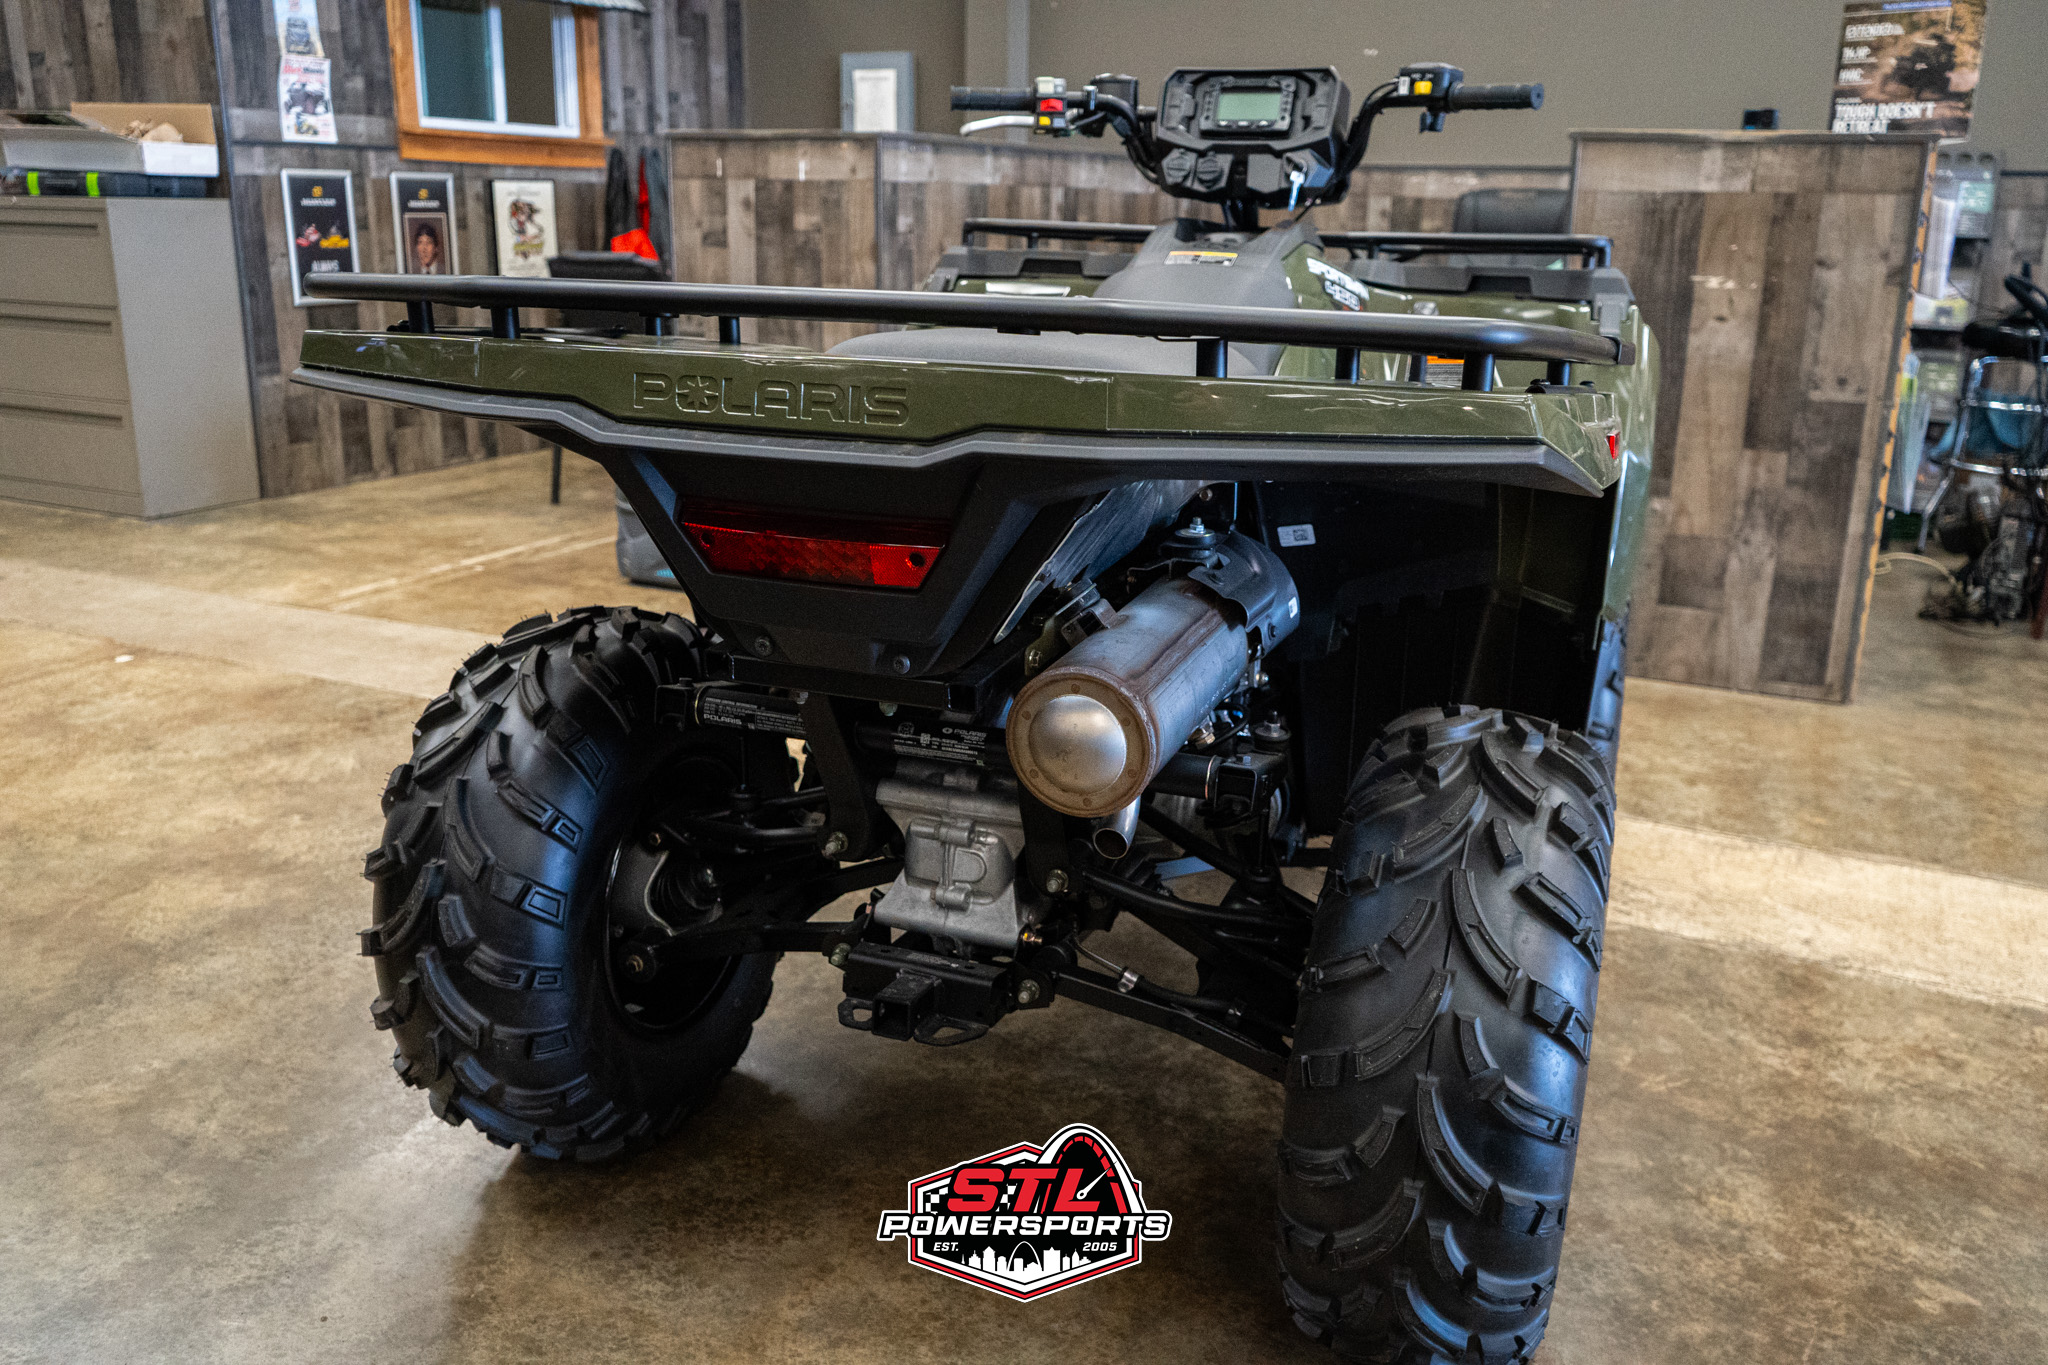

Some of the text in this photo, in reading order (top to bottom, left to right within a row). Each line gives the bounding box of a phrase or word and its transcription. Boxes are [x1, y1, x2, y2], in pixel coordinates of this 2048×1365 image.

[1835, 101, 1937, 120] TOUGH DOESN'T
[1832, 119, 1891, 133] RETREAT
[633, 372, 910, 427] POLARIS
[703, 713, 742, 725] POLARIS
[954, 728, 987, 739] POLARIS
